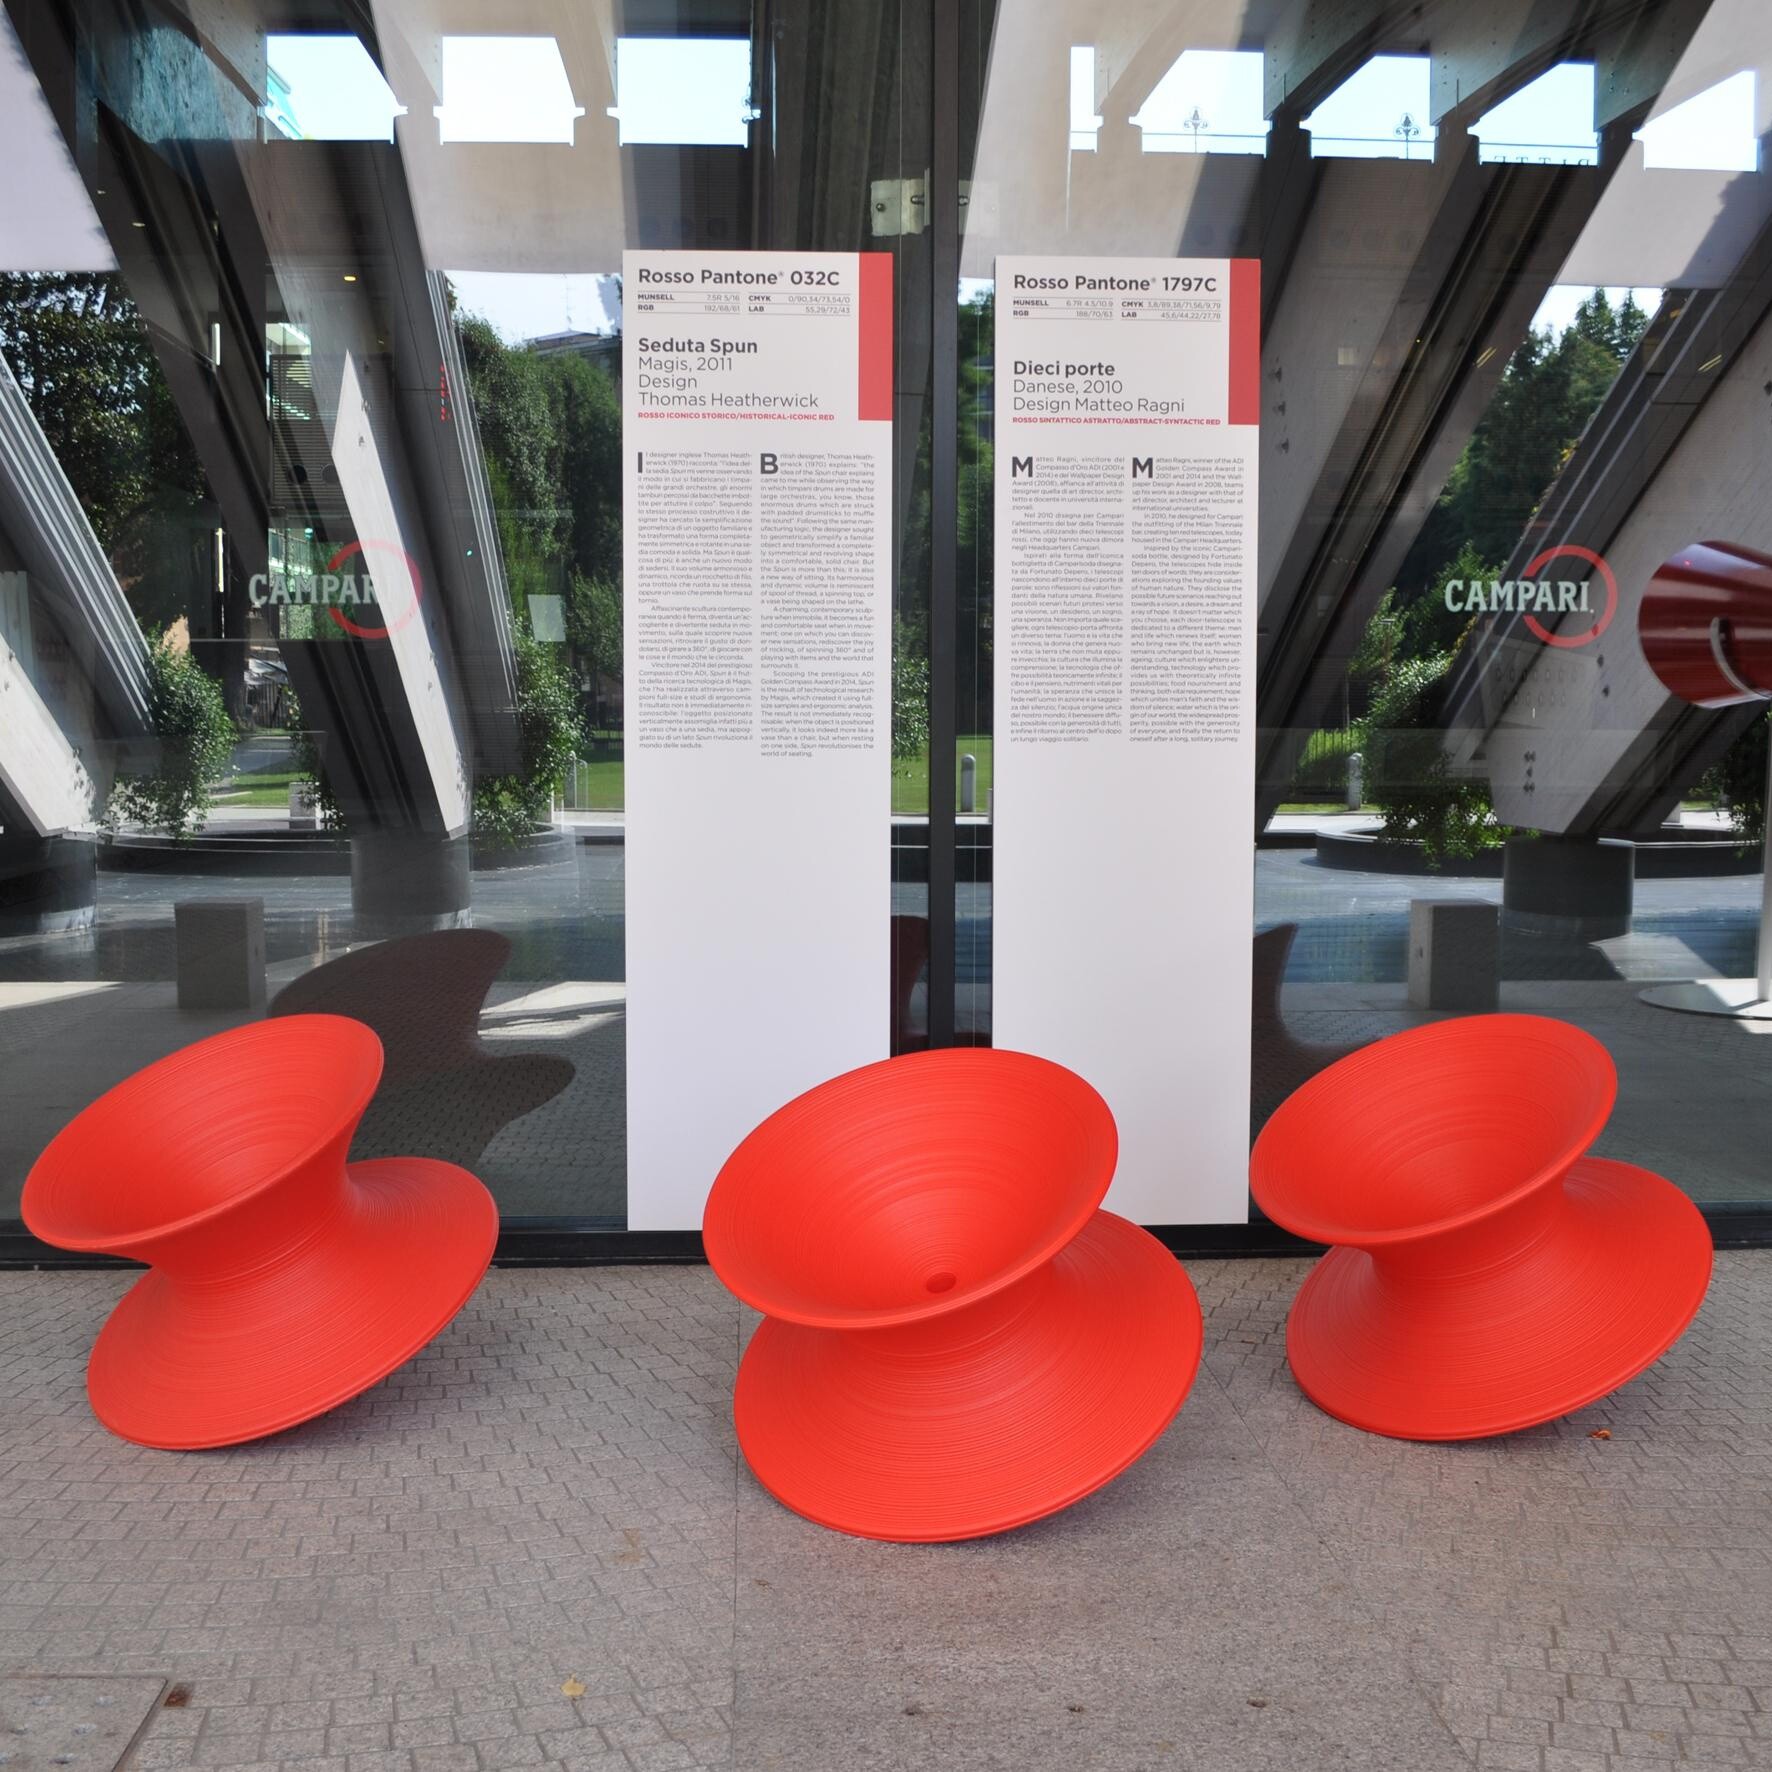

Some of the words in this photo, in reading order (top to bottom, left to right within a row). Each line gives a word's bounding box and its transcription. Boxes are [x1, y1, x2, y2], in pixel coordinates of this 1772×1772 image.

[638, 268, 694, 284] Rosso
[790, 270, 840, 286] 032C
[1013, 274, 1069, 290] Rosso
[1162, 277, 1217, 292] 1797C
[748, 305, 764, 313] LAB
[1012, 299, 1049, 307] MUNSELL
[638, 338, 705, 353] Seduta
[710, 338, 758, 356] Spun
[638, 357, 692, 373] Magis,
[696, 357, 733, 371] 2011
[1013, 360, 1060, 375] Dieci
[1065, 362, 1115, 378] porte
[639, 374, 698, 391] Design
[1013, 380, 1079, 395] Danese,
[1083, 380, 1123, 394] 2010
[638, 392, 706, 407] Thomas
[711, 393, 818, 408] Heatherwick
[1013, 397, 1071, 414] Design
[1075, 397, 1134, 412] Matteo
[1137, 398, 1185, 415] Ragni
